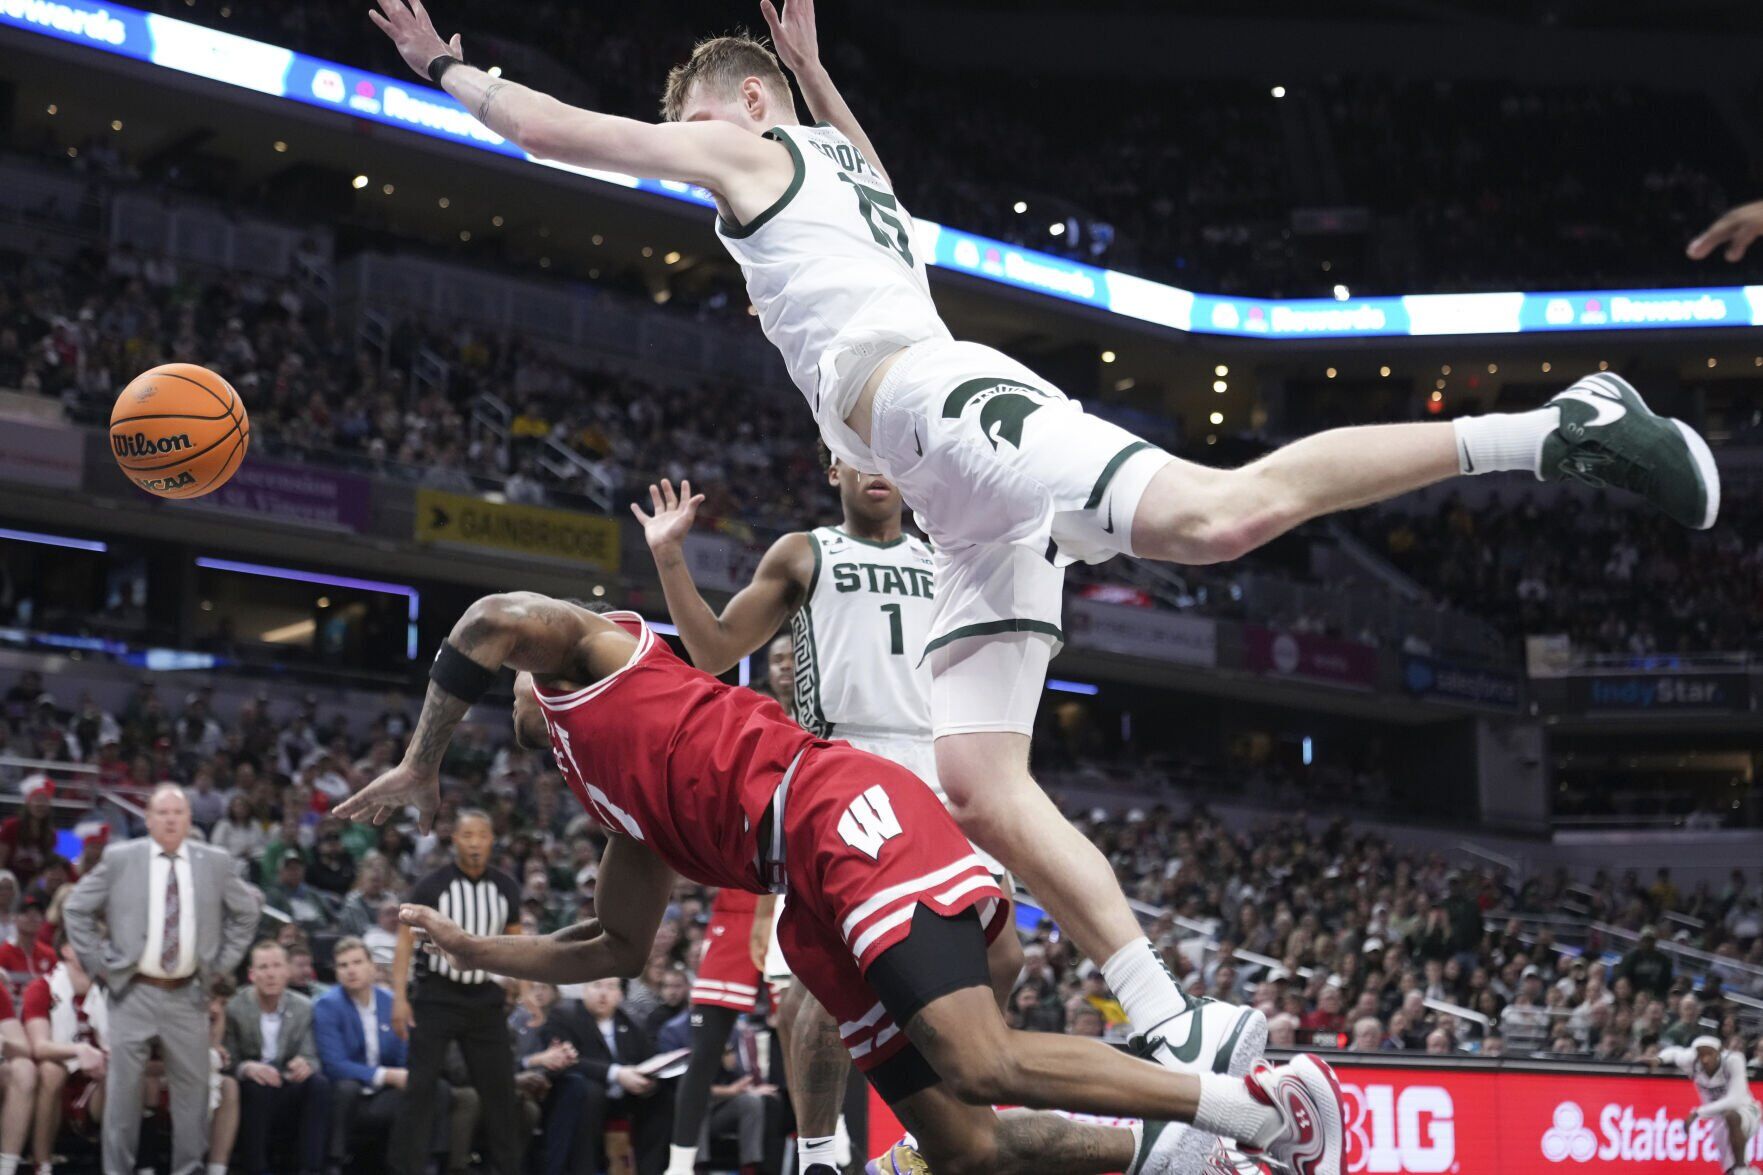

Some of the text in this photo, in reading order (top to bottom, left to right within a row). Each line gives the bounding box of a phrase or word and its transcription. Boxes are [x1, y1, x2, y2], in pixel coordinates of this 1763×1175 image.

[808, 140, 880, 175] COOP
[837, 171, 914, 269] 15
[112, 432, 192, 458] Wilson
[832, 562, 934, 600] STATE
[880, 603, 904, 655] 1
[837, 783, 904, 862] W
